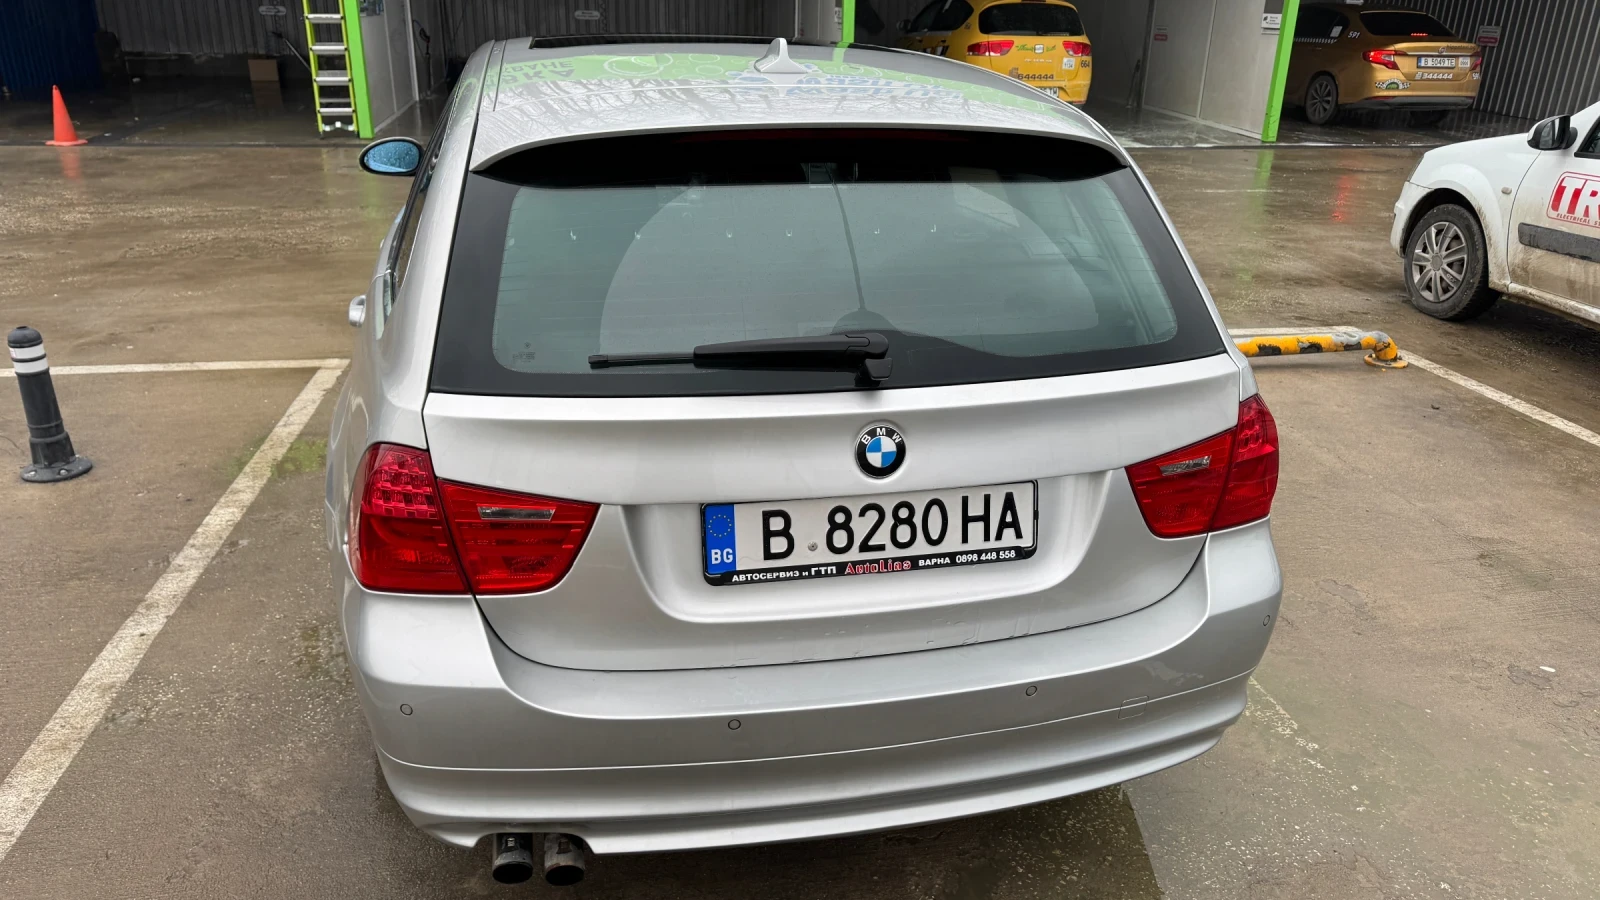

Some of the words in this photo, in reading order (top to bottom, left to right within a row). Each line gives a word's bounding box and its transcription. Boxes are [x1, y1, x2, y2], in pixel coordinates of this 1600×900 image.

[1556, 213, 1591, 225] ELECTRICAL
[861, 427, 902, 444] BMW
[762, 510, 795, 561] B
[825, 498, 949, 555] 8280
[960, 491, 1024, 545] HA
[711, 548, 733, 565] BG
[732, 570, 800, 582] АВТОСЕРВИЗ
[811, 565, 837, 576] ГТП
[918, 557, 951, 567] ВАРНА
[956, 553, 979, 563] 0898
[980, 551, 997, 561] 448
[999, 550, 1016, 559] 558
